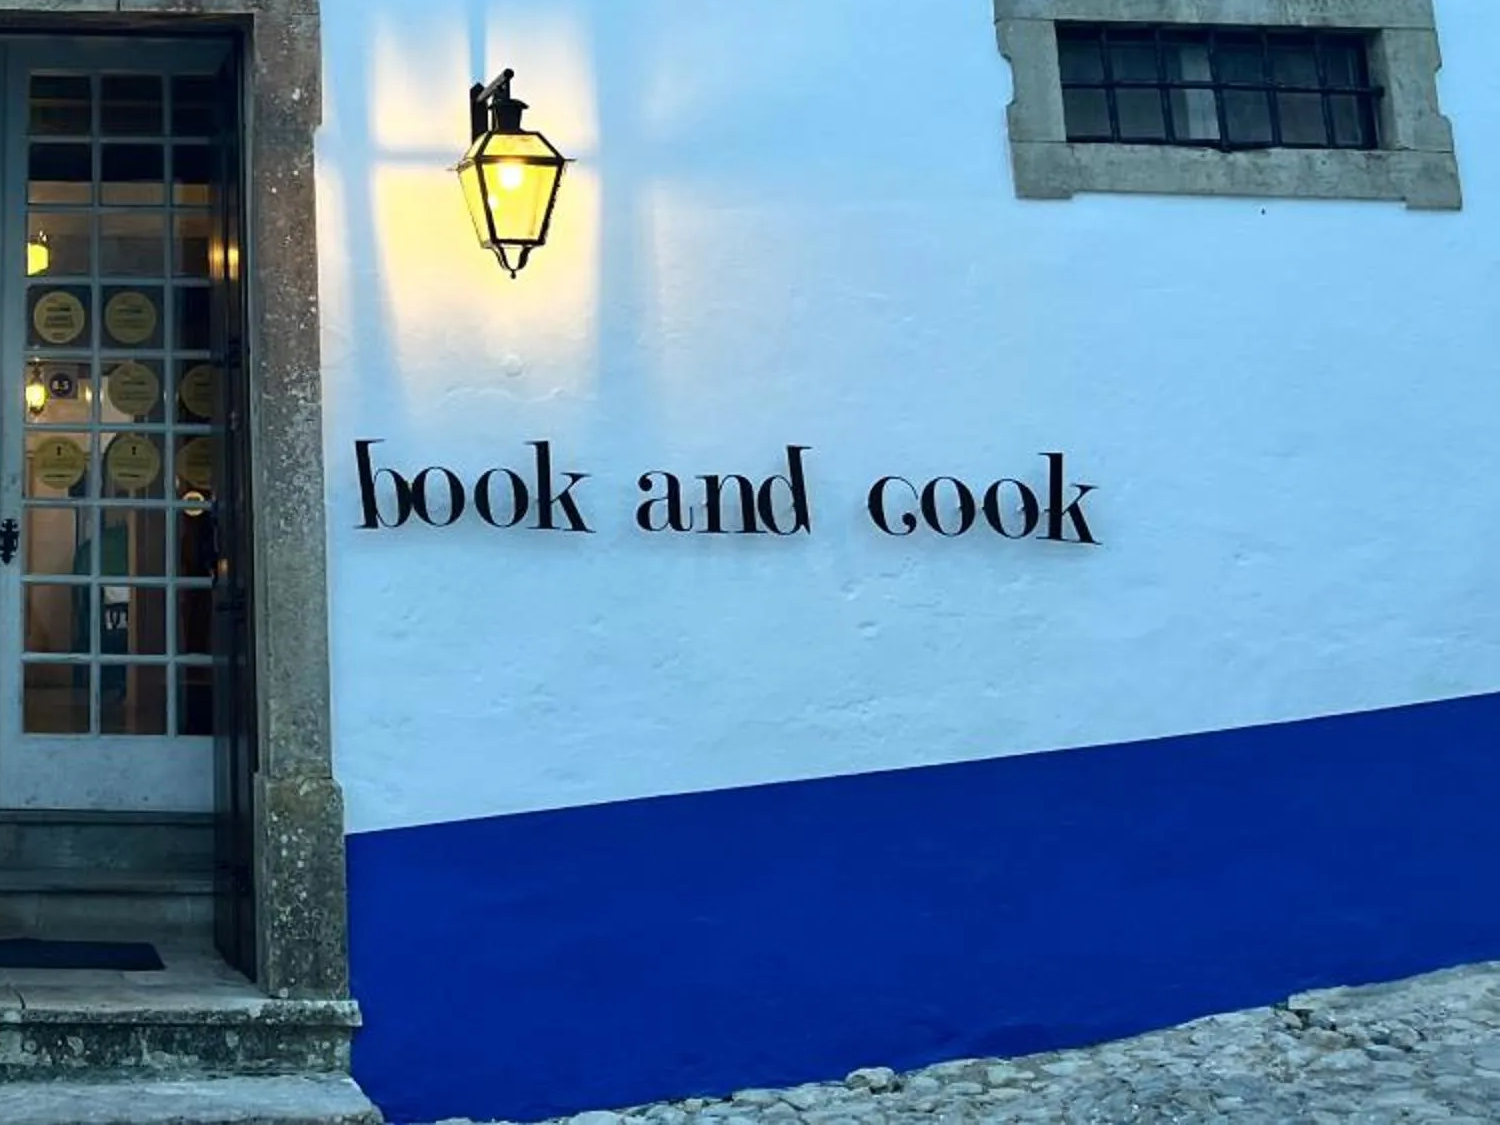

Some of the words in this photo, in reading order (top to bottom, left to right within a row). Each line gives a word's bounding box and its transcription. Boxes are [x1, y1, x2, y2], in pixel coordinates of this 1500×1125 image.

[355, 439, 599, 534] book
[634, 445, 812, 536] and
[867, 452, 1103, 546] cook
